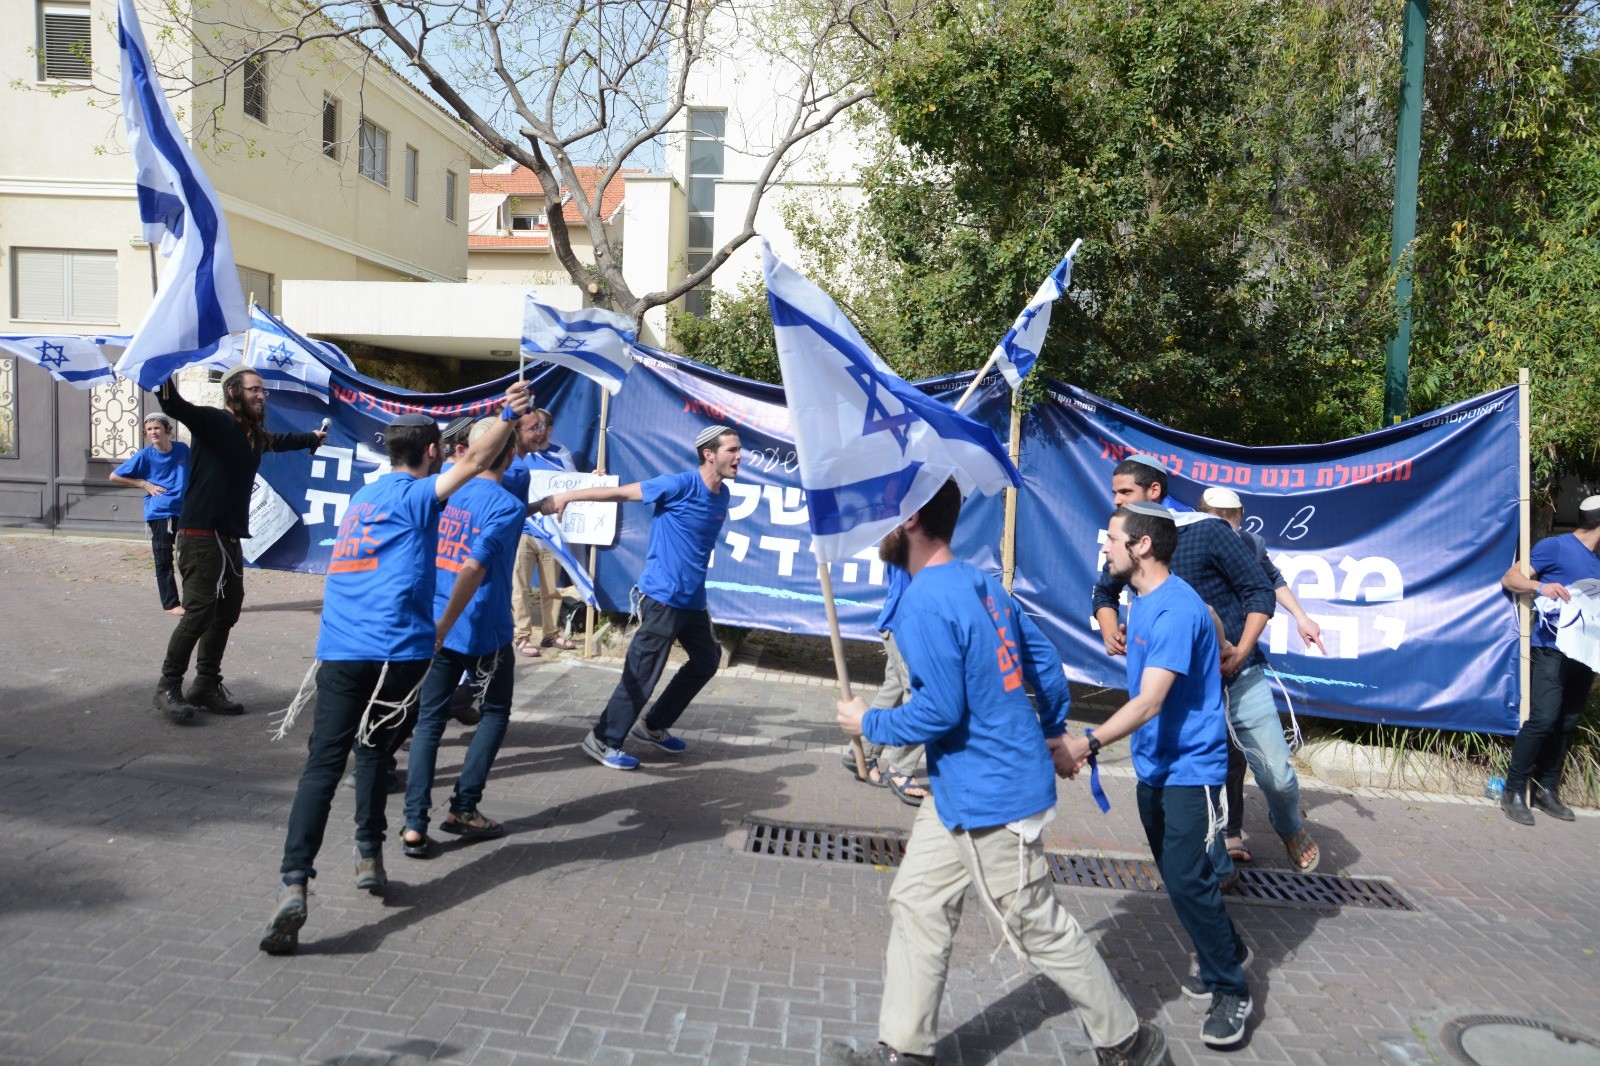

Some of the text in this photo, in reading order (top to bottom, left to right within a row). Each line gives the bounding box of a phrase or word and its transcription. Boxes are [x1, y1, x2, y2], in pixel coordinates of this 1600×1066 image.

[748, 447, 800, 473] שעה
[1192, 461, 1252, 485] סכנה
[1261, 467, 1305, 488] בנט
[1315, 459, 1412, 488] ממשלת
